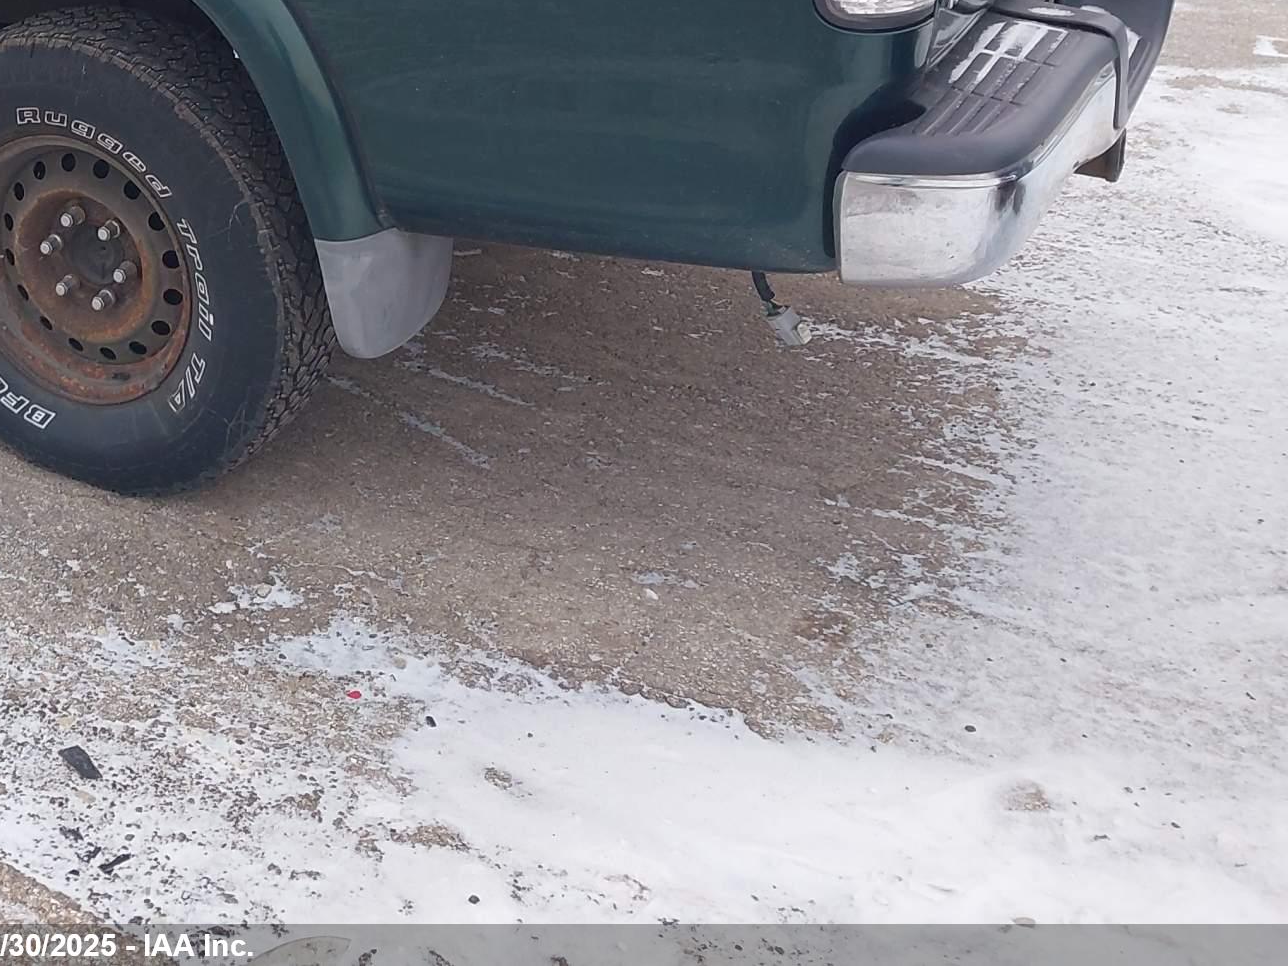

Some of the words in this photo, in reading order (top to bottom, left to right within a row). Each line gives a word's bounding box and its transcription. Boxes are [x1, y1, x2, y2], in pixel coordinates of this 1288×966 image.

[15, 107, 172, 199] Rugged
[176, 218, 216, 341] Trail
[167, 352, 207, 413] T/A
